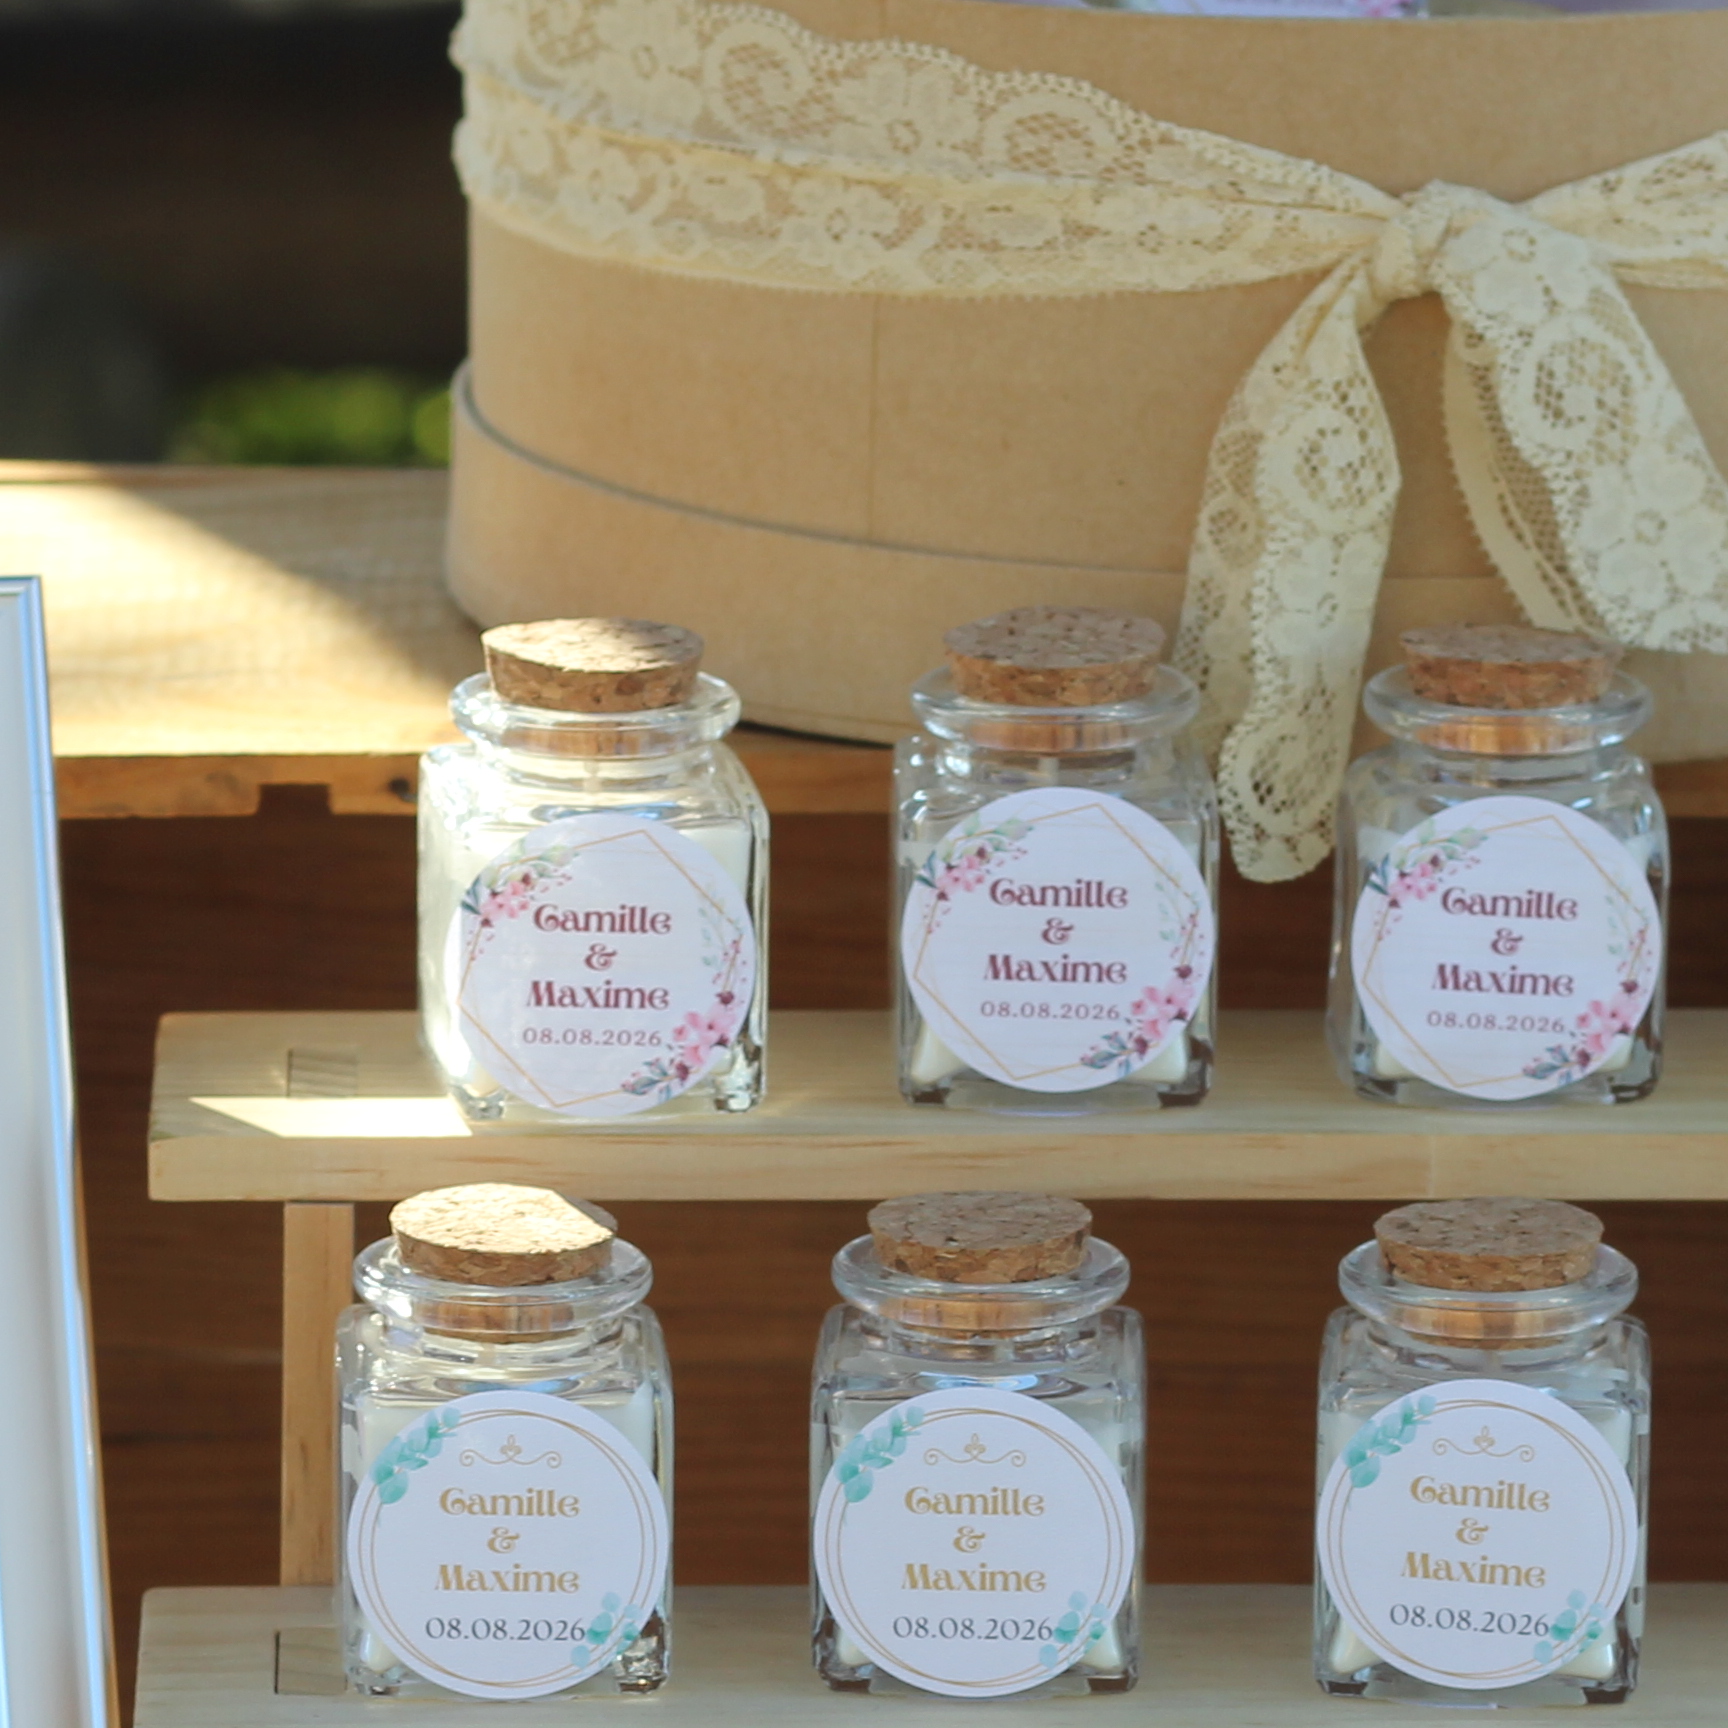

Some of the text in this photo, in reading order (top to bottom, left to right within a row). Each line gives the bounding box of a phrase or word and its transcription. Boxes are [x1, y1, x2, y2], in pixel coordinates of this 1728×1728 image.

[989, 878, 1127, 909] Camille
[1441, 887, 1578, 922] Camille
[533, 904, 672, 936] Camille
[1040, 917, 1073, 945] &
[1490, 928, 1522, 955] &
[584, 943, 617, 970] &
[983, 953, 1127, 984] Maxime
[526, 980, 669, 1010] Maxime
[1431, 964, 1574, 997] Maxime
[980, 1002, 1120, 1020] 08.08.2026
[1427, 1011, 1566, 1033] 08.08.2026
[522, 1028, 662, 1046] 08.08.2026
[439, 1487, 579, 1517] Camille
[904, 1487, 1044, 1517] Camille
[1409, 1476, 1551, 1513] Camille
[487, 1526, 520, 1553] &
[953, 1525, 986, 1553] &
[1455, 1516, 1488, 1545] &
[435, 1564, 579, 1593] Maxime
[902, 1563, 1046, 1593] Maxime
[1400, 1552, 1546, 1589] Maxime
[425, 1616, 586, 1642] 08.08.2026
[892, 1616, 1053, 1642] 08.08.2026
[1389, 1603, 1550, 1636] 08.08.2026
